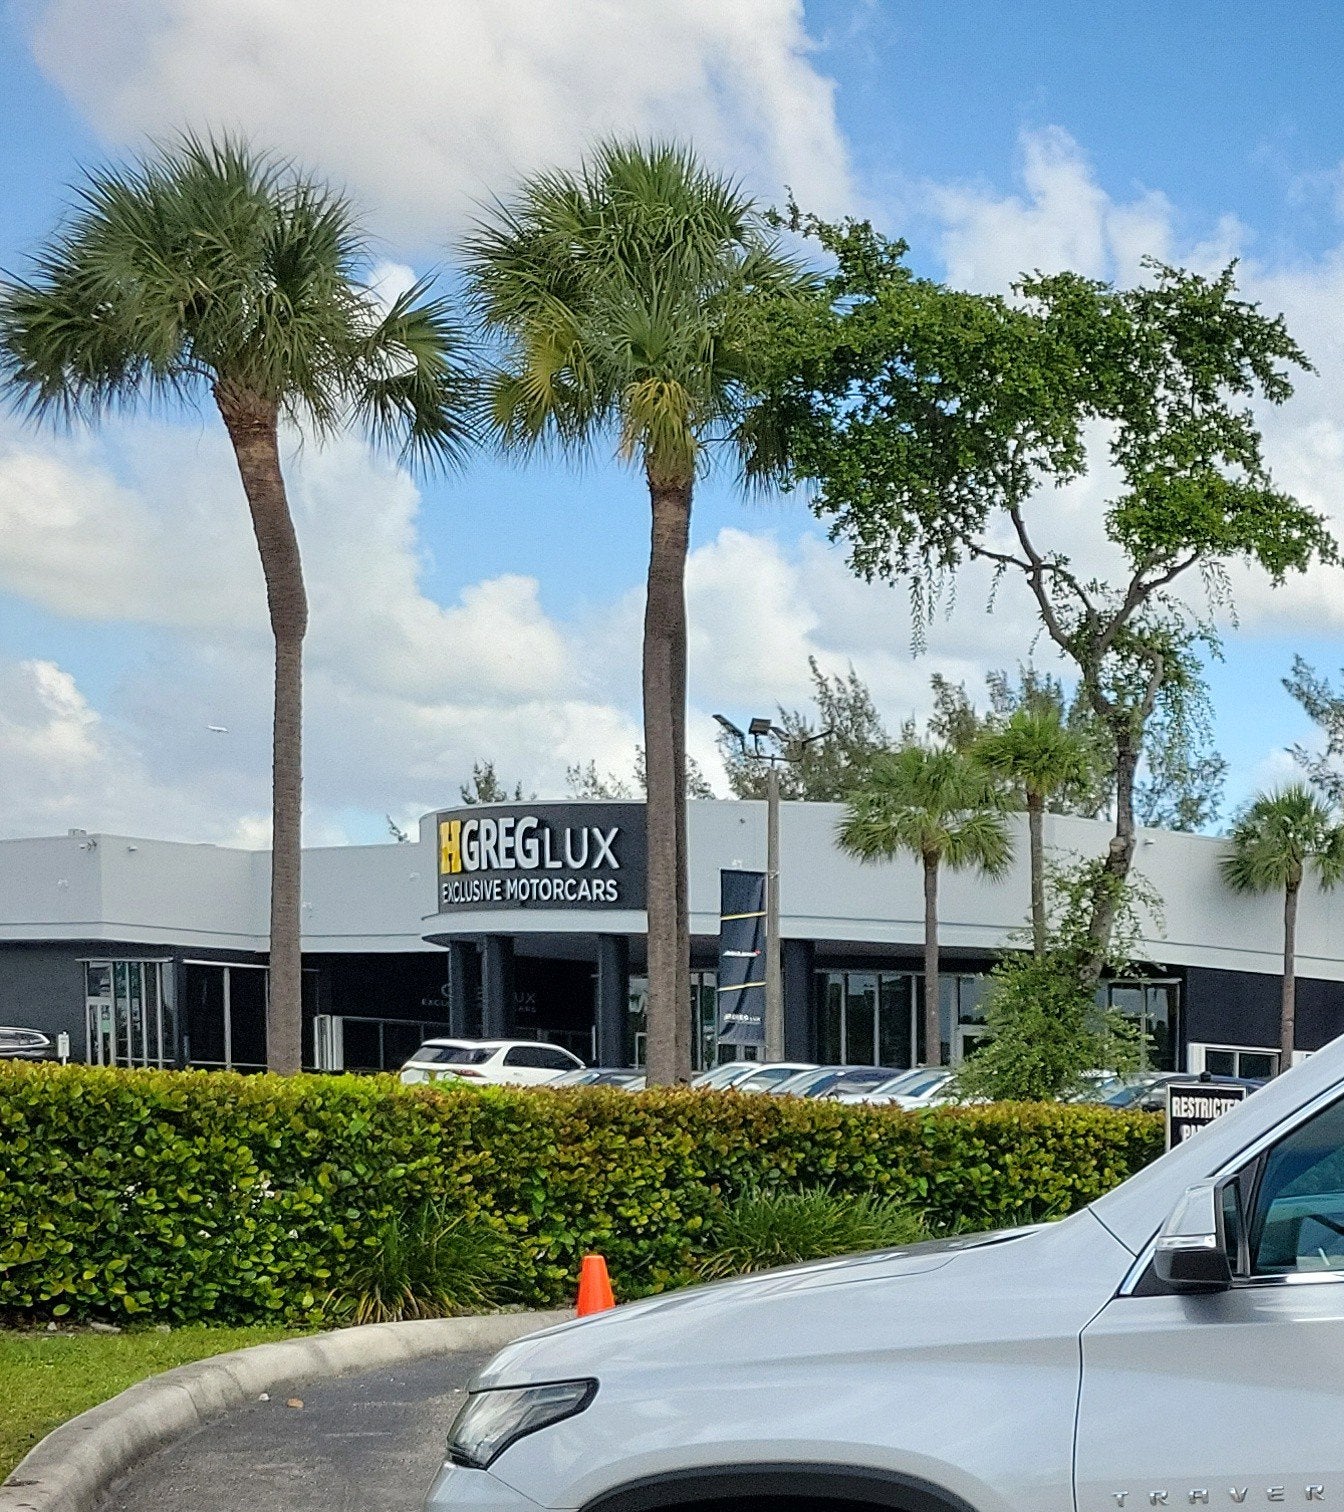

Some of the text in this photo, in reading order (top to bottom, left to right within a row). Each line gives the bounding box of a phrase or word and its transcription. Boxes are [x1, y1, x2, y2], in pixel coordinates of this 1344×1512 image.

[442, 878, 618, 903] EXCLUSIVE MOTORCARS
[1172, 1096, 1243, 1119] RESTRICT
